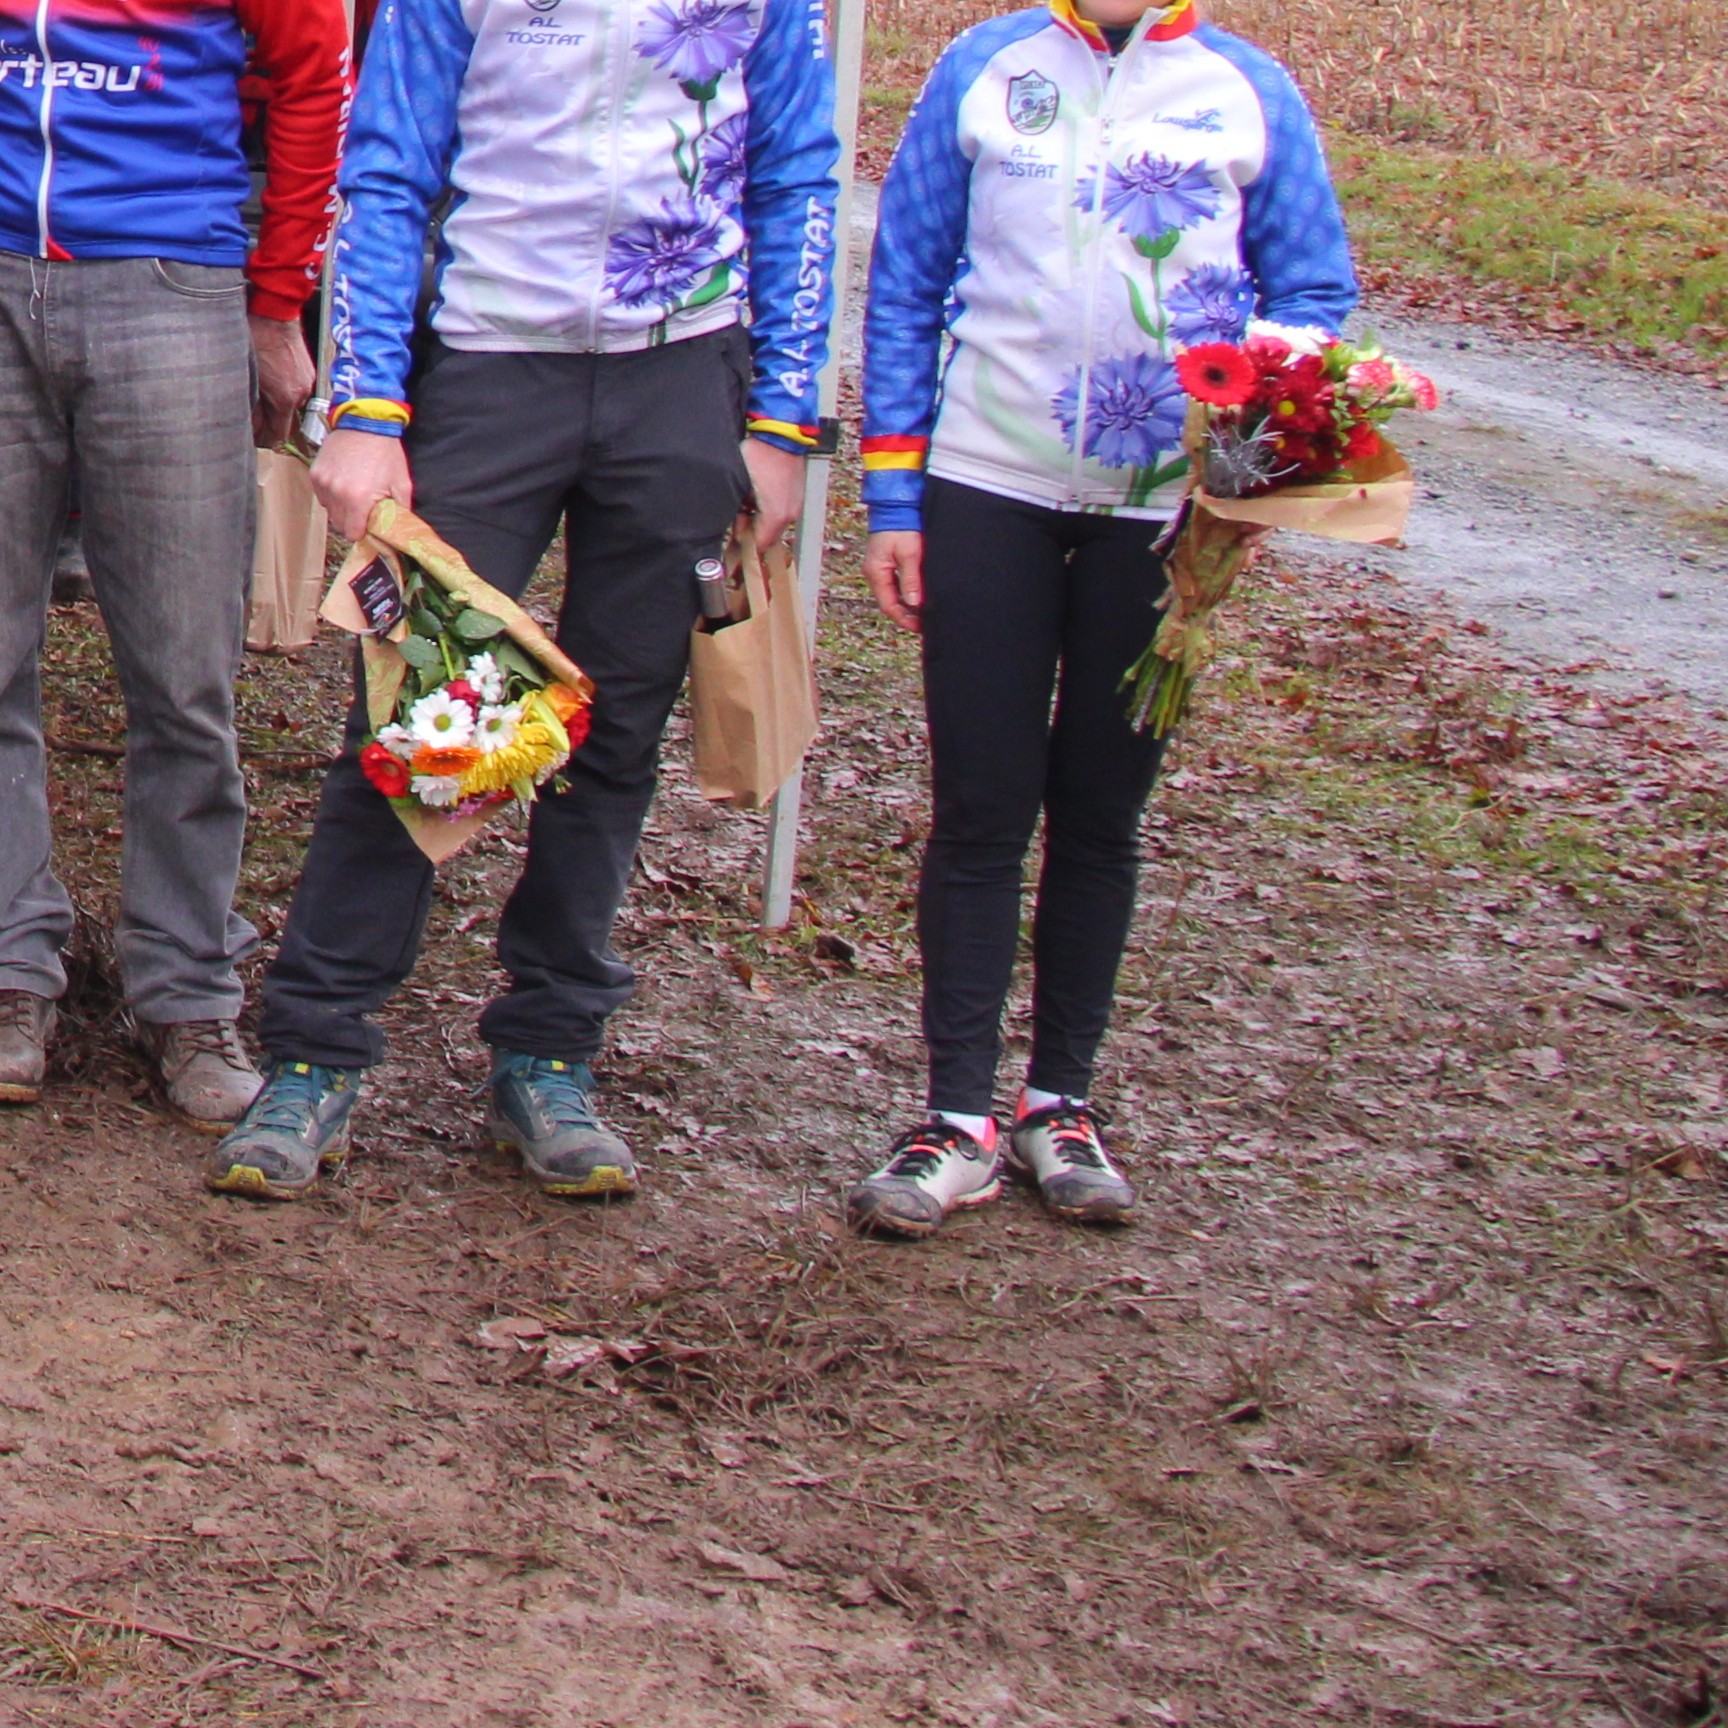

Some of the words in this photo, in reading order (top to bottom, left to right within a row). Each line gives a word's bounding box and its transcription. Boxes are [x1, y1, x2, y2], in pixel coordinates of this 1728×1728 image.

[505, 31, 586, 45] TOSTAT
[999, 161, 1057, 178] TOSTAT
[791, 195, 832, 330] TOSTAT
